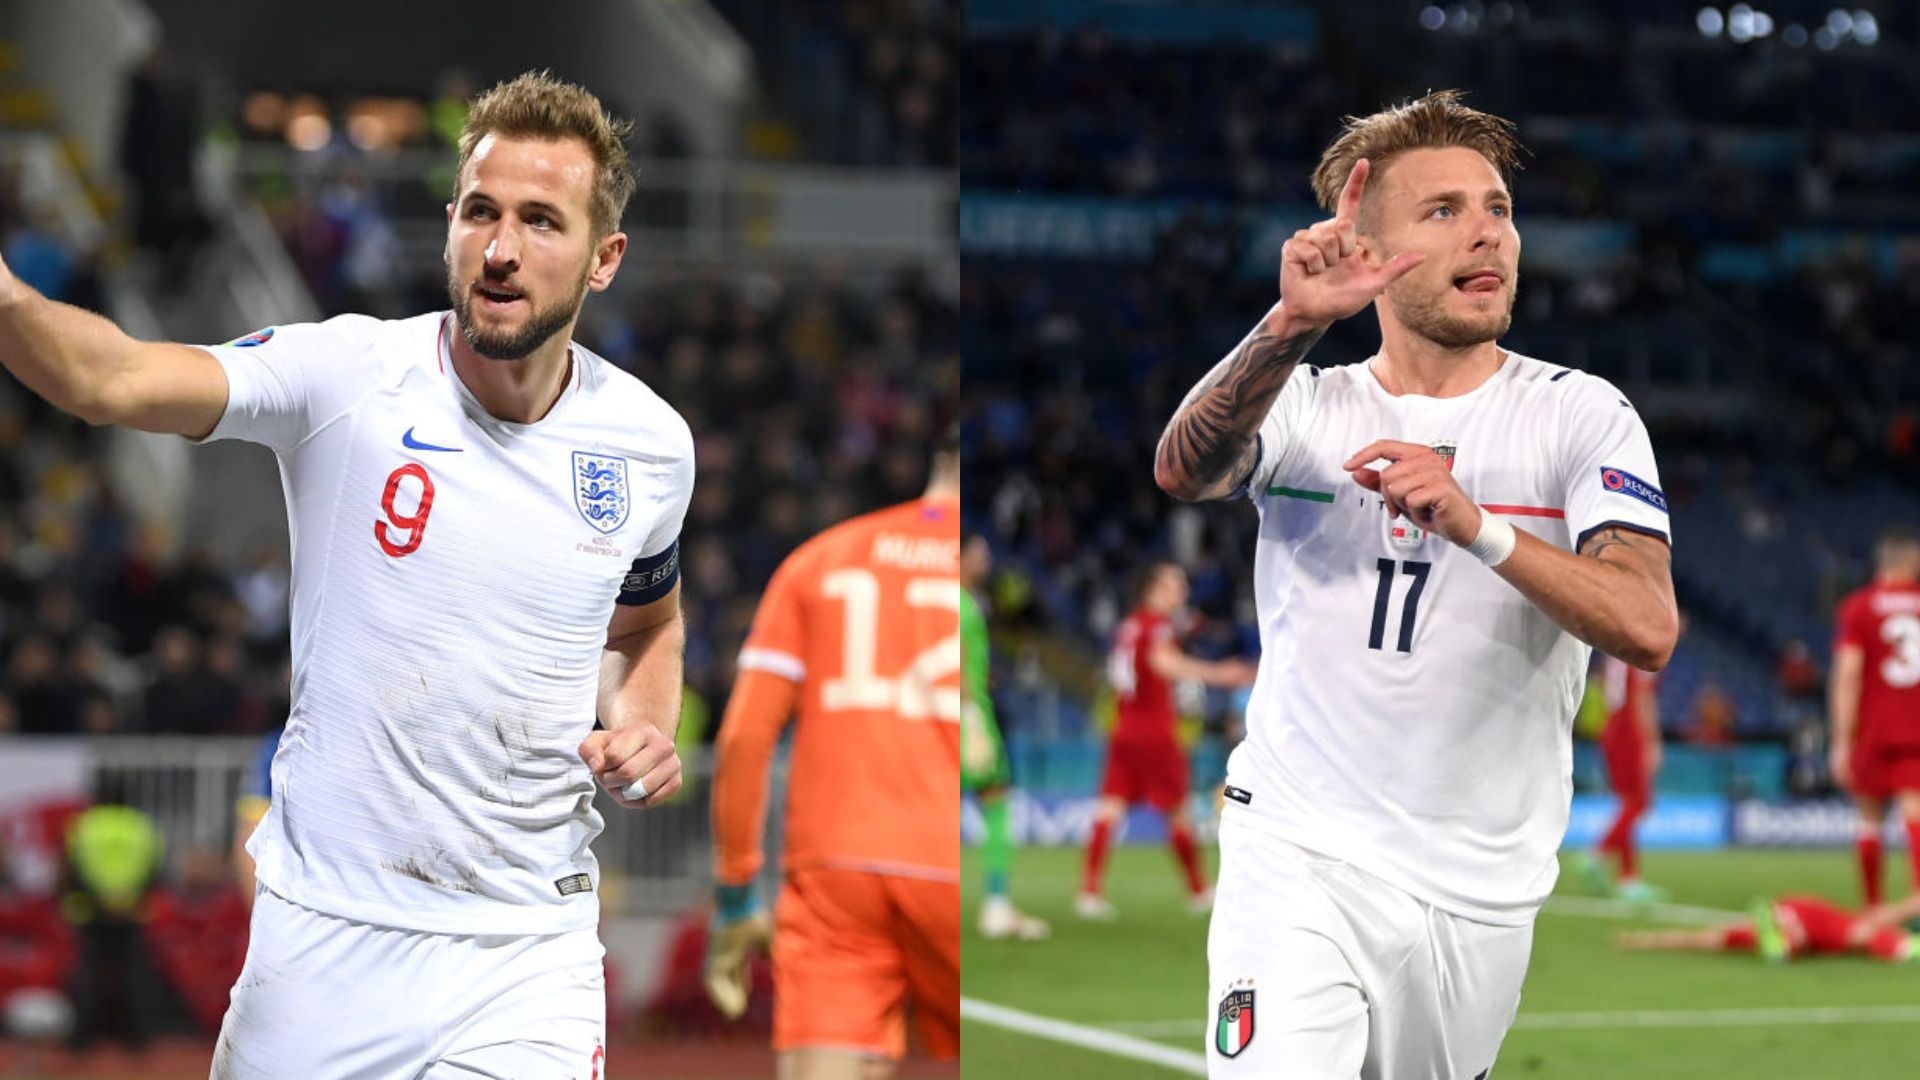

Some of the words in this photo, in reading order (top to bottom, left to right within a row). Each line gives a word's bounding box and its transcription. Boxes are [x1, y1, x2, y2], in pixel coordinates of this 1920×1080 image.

[374, 463, 435, 558] 9
[822, 569, 960, 722] 12
[1368, 557, 1432, 653] 17
